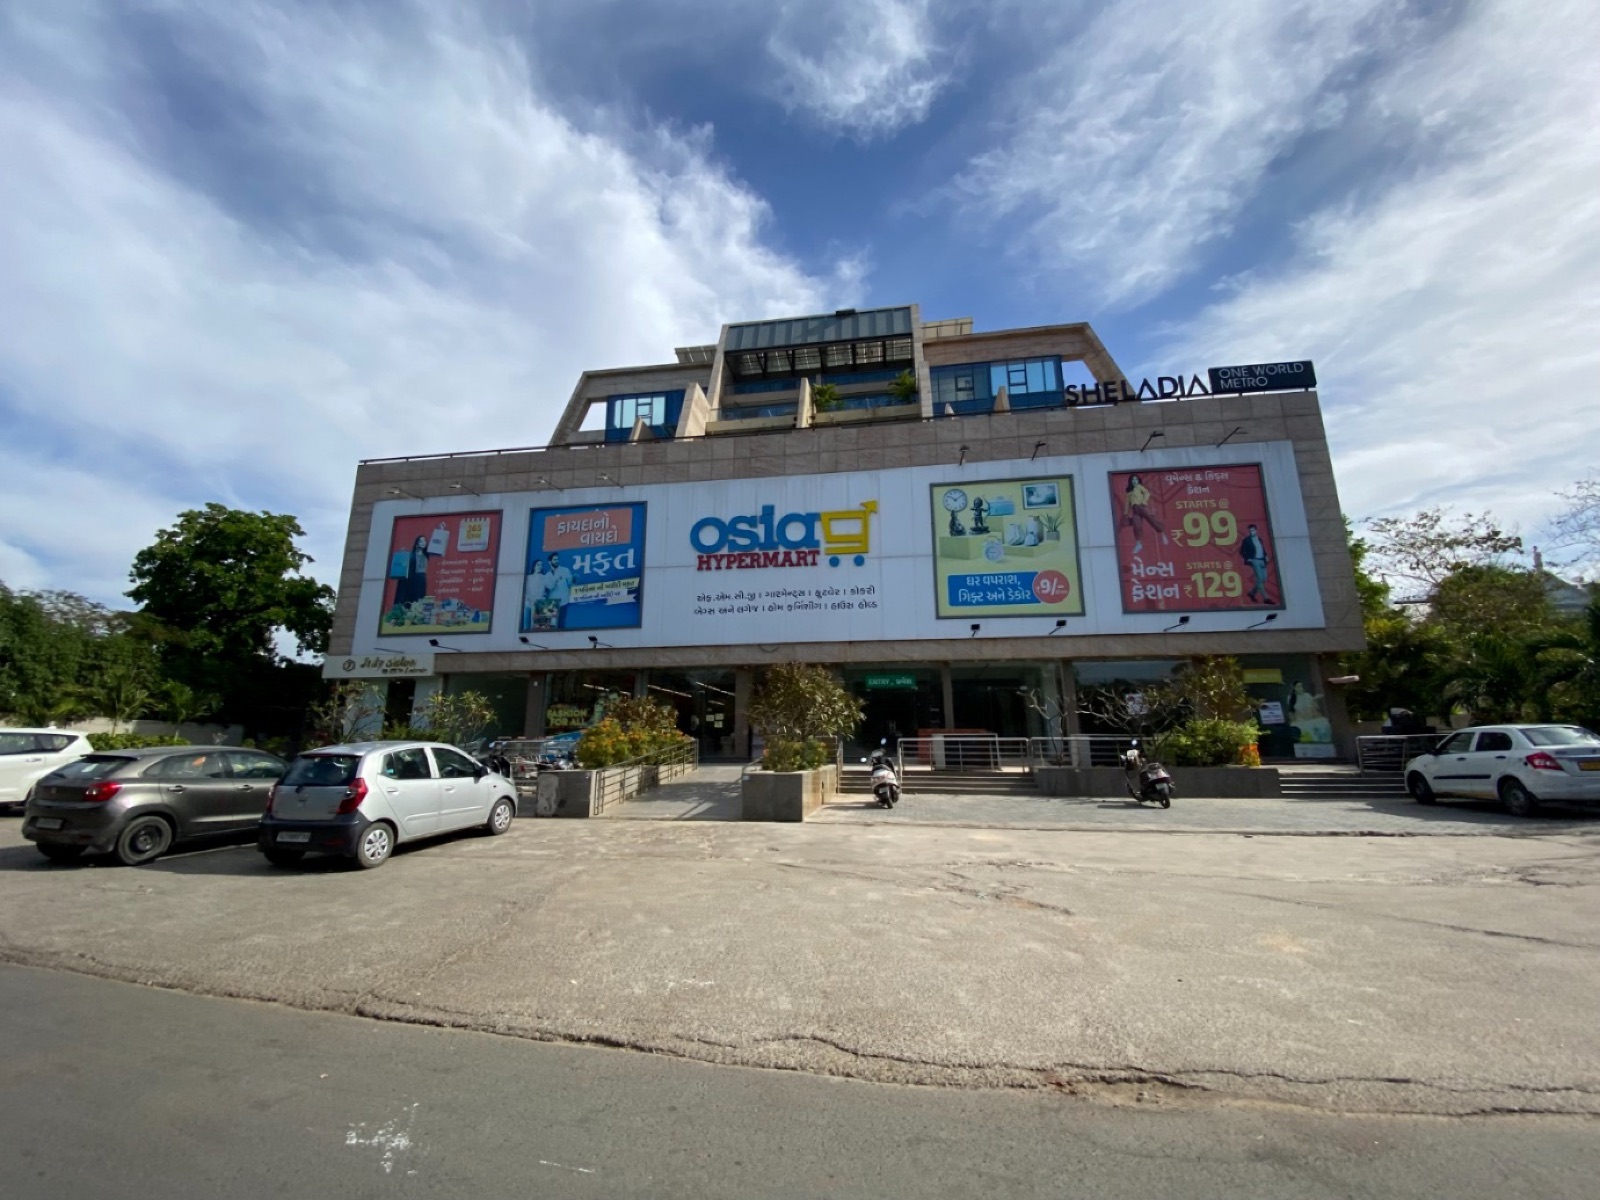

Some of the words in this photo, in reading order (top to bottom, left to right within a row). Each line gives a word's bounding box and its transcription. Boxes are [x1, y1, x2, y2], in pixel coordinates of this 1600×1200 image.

[1218, 367, 1249, 380] ONE
[1252, 362, 1304, 377] WORLD
[1066, 374, 1209, 406] SHELADIA
[1220, 376, 1268, 389] METRO
[1176, 499, 1216, 509] STARTS
[1219, 498, 1229, 508] @
[557, 511, 610, 536] ફાયદાનો
[690, 504, 821, 554] osia
[580, 524, 618, 545] વાયદો
[572, 547, 636, 576] મફત
[697, 550, 820, 571] HYPERMART
[1131, 556, 1175, 577] મેન્સ
[1186, 561, 1221, 569] STARTS
[966, 576, 981, 587] ઘર
[1131, 578, 1180, 603] ફેશન
[987, 587, 1006, 601] અને
[1007, 586, 1031, 600] ડેકોર
[718, 604, 734, 614] અને
[737, 603, 758, 613] લગેજ
[768, 602, 784, 612] હોમ
[547, 708, 588, 718] FASHION
[549, 717, 569, 727] FOR
